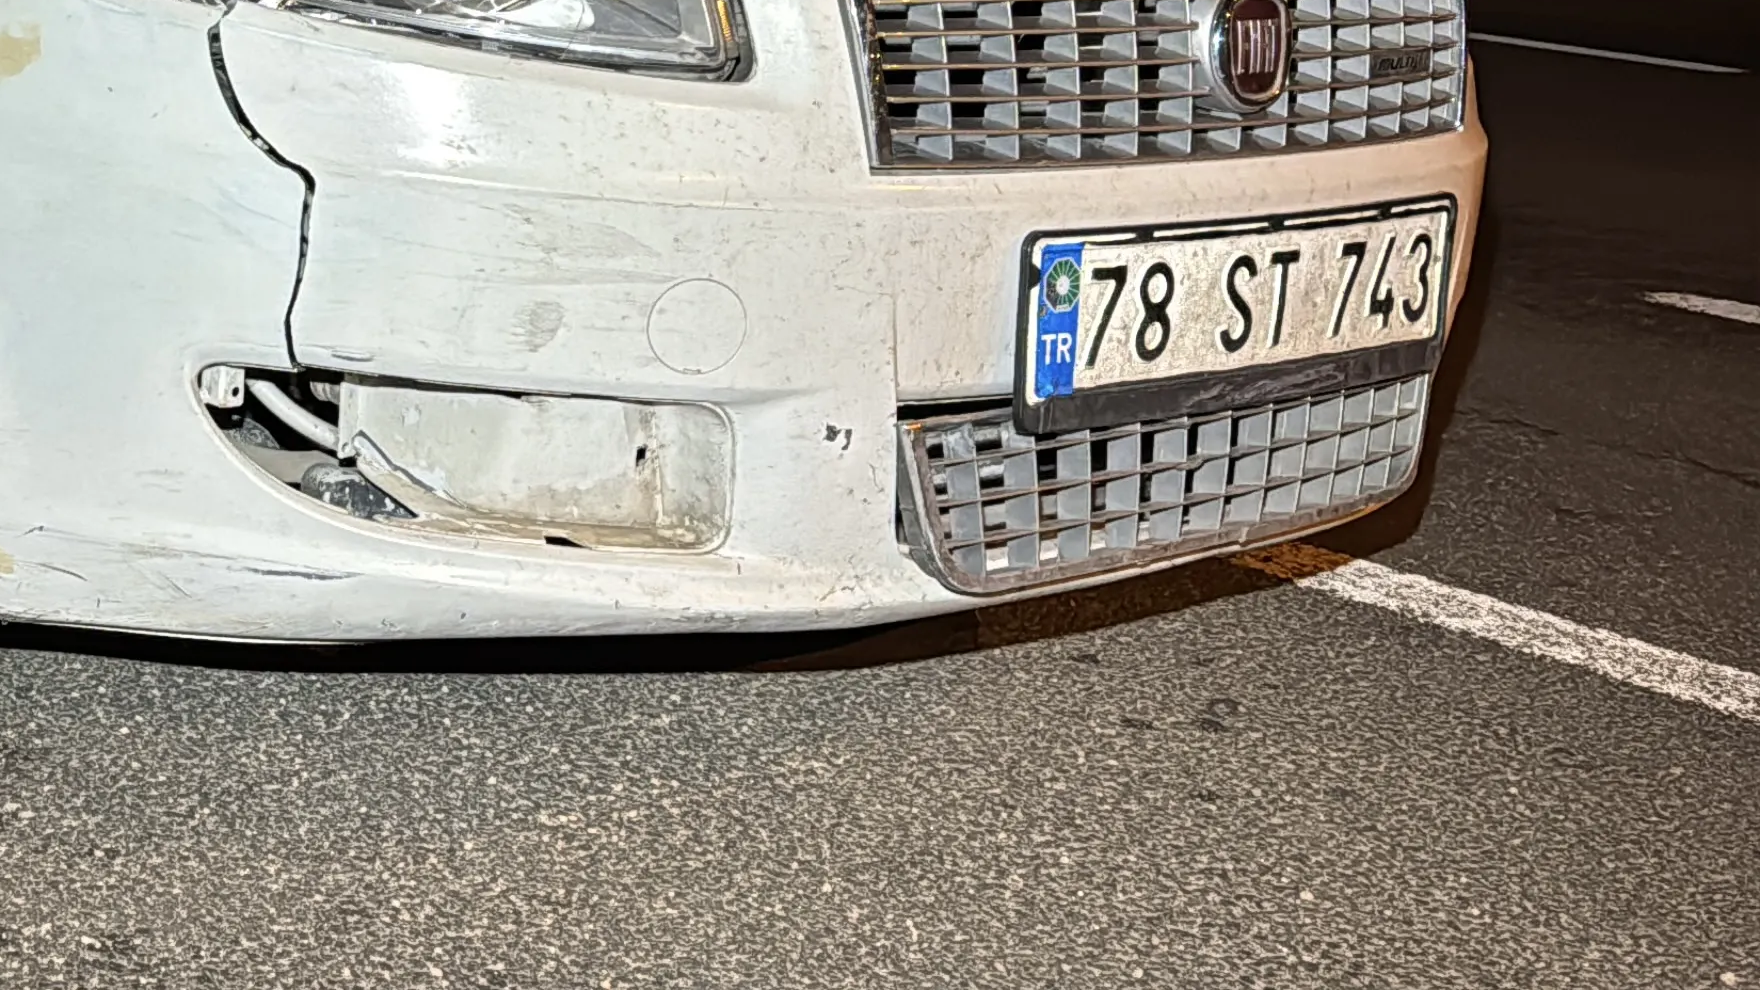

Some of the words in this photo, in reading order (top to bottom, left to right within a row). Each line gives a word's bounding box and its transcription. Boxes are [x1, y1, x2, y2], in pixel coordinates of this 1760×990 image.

[1084, 261, 1175, 370] 78
[1218, 249, 1301, 353] ST
[1327, 233, 1433, 339] 743
[1041, 332, 1072, 366] TR
